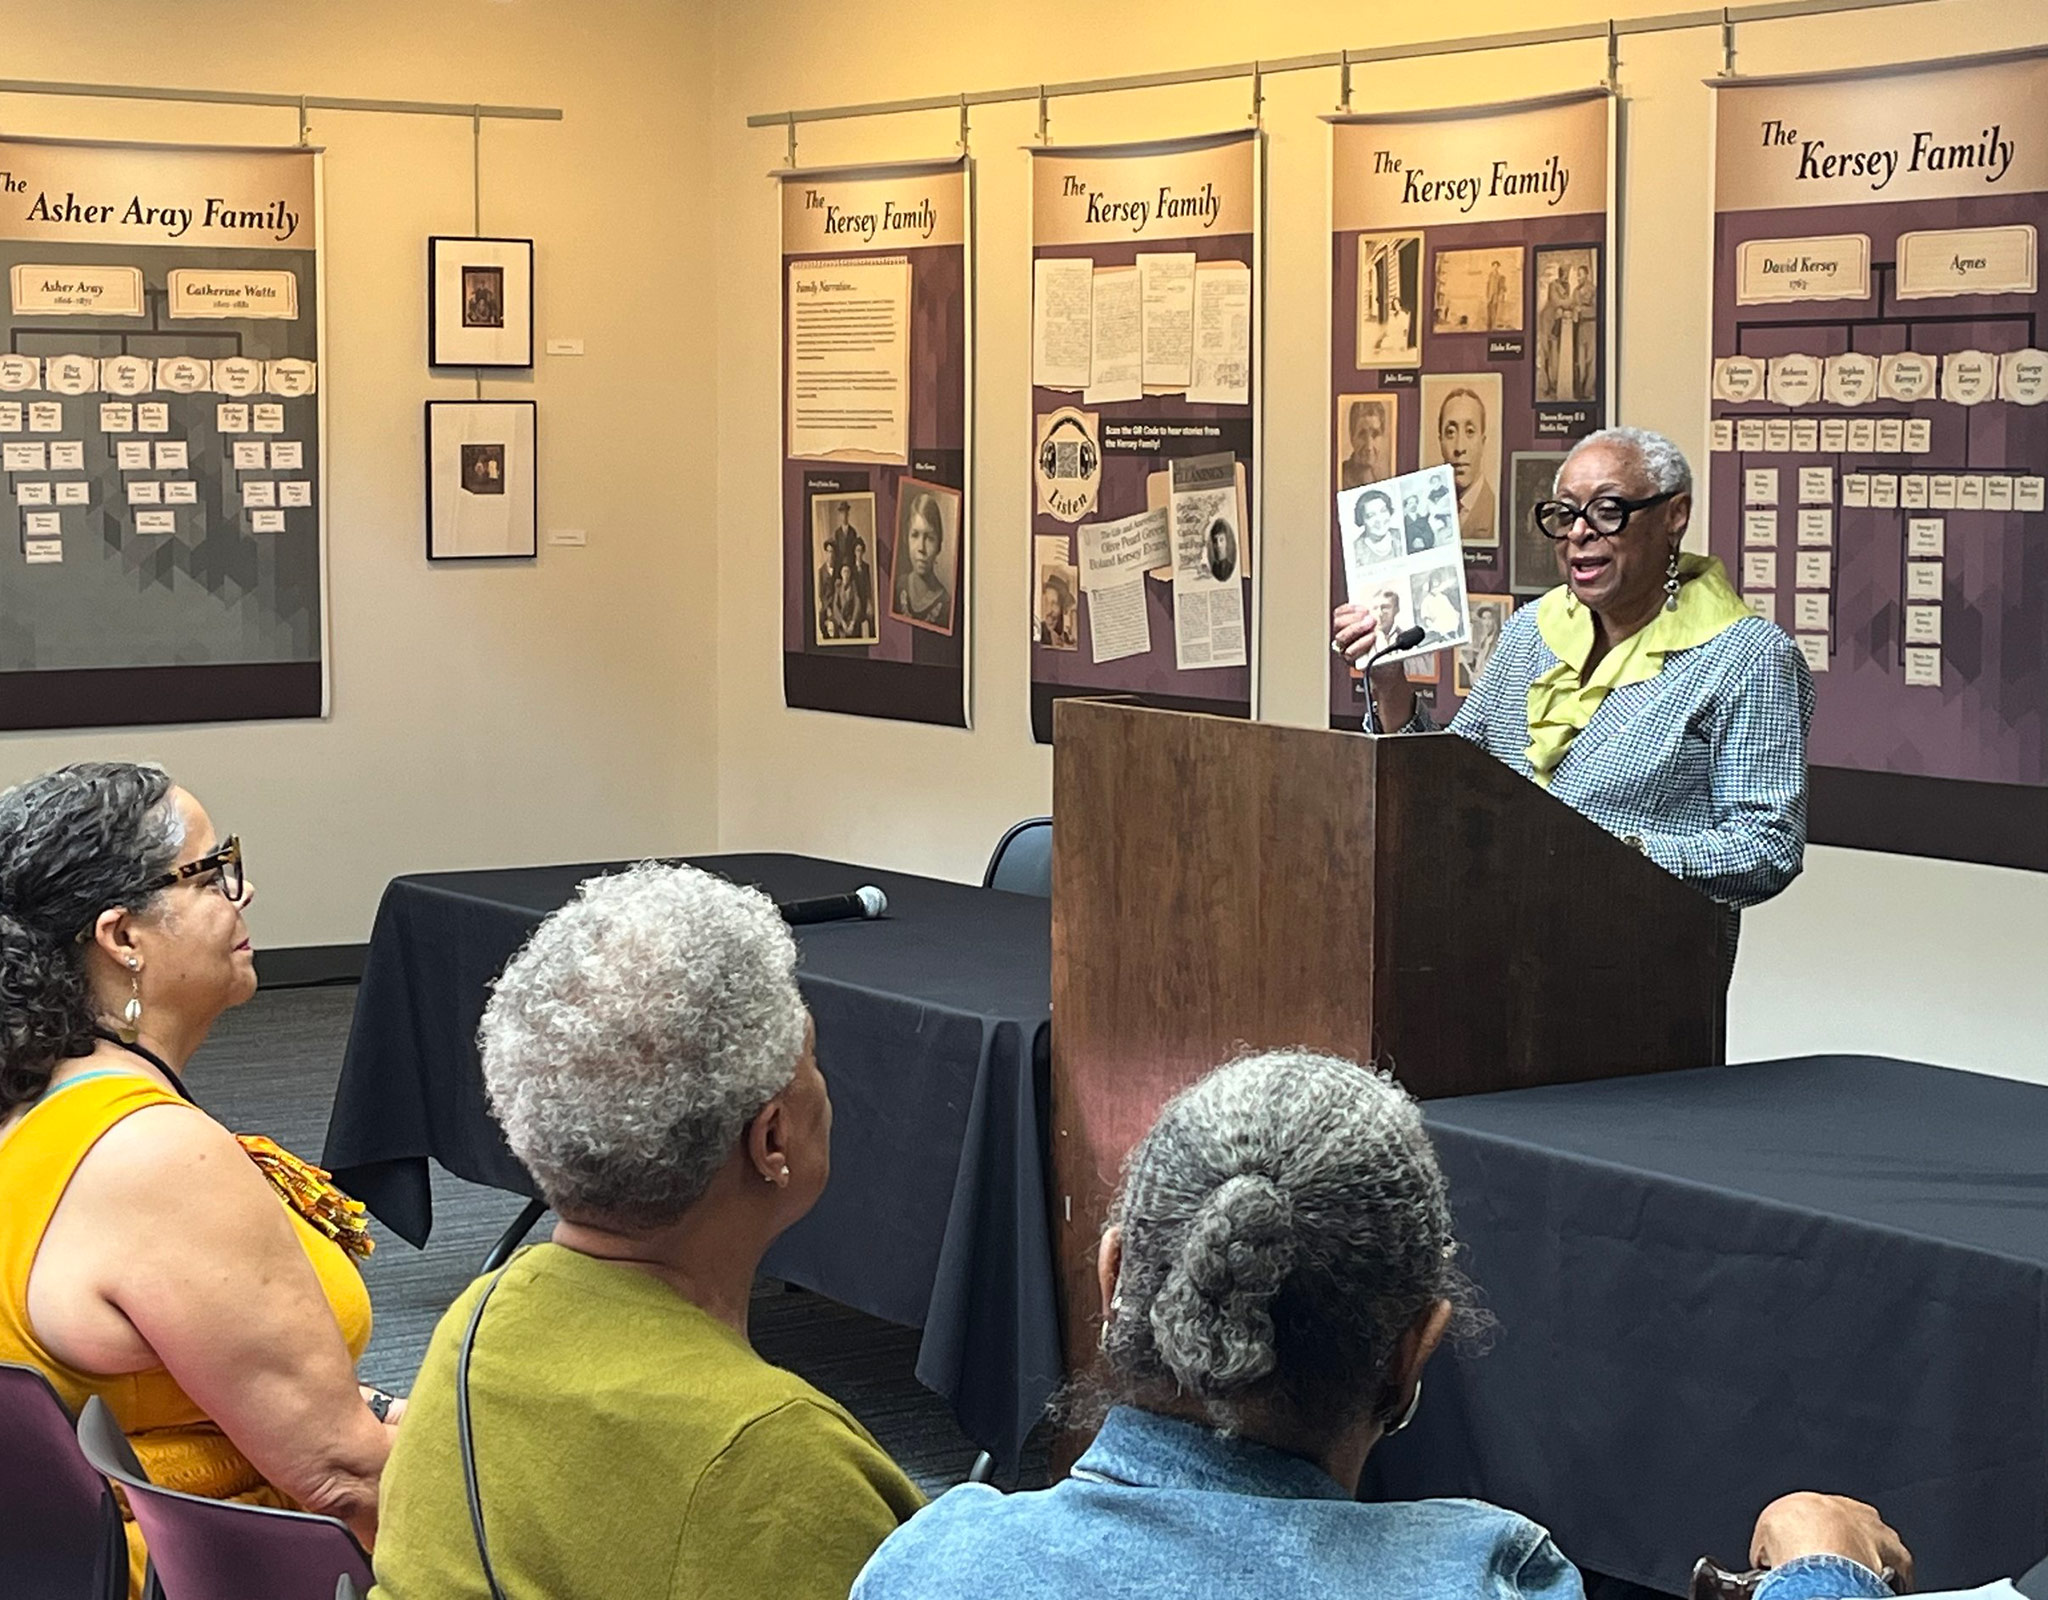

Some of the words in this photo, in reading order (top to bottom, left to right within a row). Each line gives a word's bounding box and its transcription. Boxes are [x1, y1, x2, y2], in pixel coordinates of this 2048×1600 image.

[1761, 120, 1797, 146] The
[1374, 151, 1402, 174] The
[1796, 140, 1898, 190] Kersey
[1907, 125, 2014, 183] Family
[0, 172, 27, 193] he
[1062, 175, 1086, 197] The
[1401, 168, 1481, 213] Kersey
[1488, 155, 1569, 206] Family
[805, 190, 825, 209] The
[1085, 192, 1150, 233] Kersey
[1156, 183, 1221, 228] Family
[26, 192, 114, 223] Asher
[121, 195, 192, 237] Aray
[202, 198, 299, 241] Family
[824, 205, 878, 243] Kersey
[883, 198, 936, 239] Family
[1762, 257, 1797, 274] David
[1799, 257, 1838, 277] Kersey
[1950, 254, 1986, 275] Agnes
[41, 280, 73, 292] Asher
[76, 282, 104, 297] Aray
[186, 283, 241, 297] Catherine
[244, 285, 276, 297] Watts
[1105, 425, 1121, 436] Scan
[1121, 425, 1132, 436] the
[1132, 425, 1143, 436] QR
[1143, 425, 1159, 436] Code
[1159, 425, 1167, 436] to
[1167, 425, 1182, 436] hear
[1182, 426, 1204, 436] stories
[1204, 425, 1221, 436] from
[1105, 438, 1116, 449] the
[1116, 438, 1138, 451] Kersey
[1138, 438, 1161, 451] Family!
[1048, 488, 1088, 516] Listen
